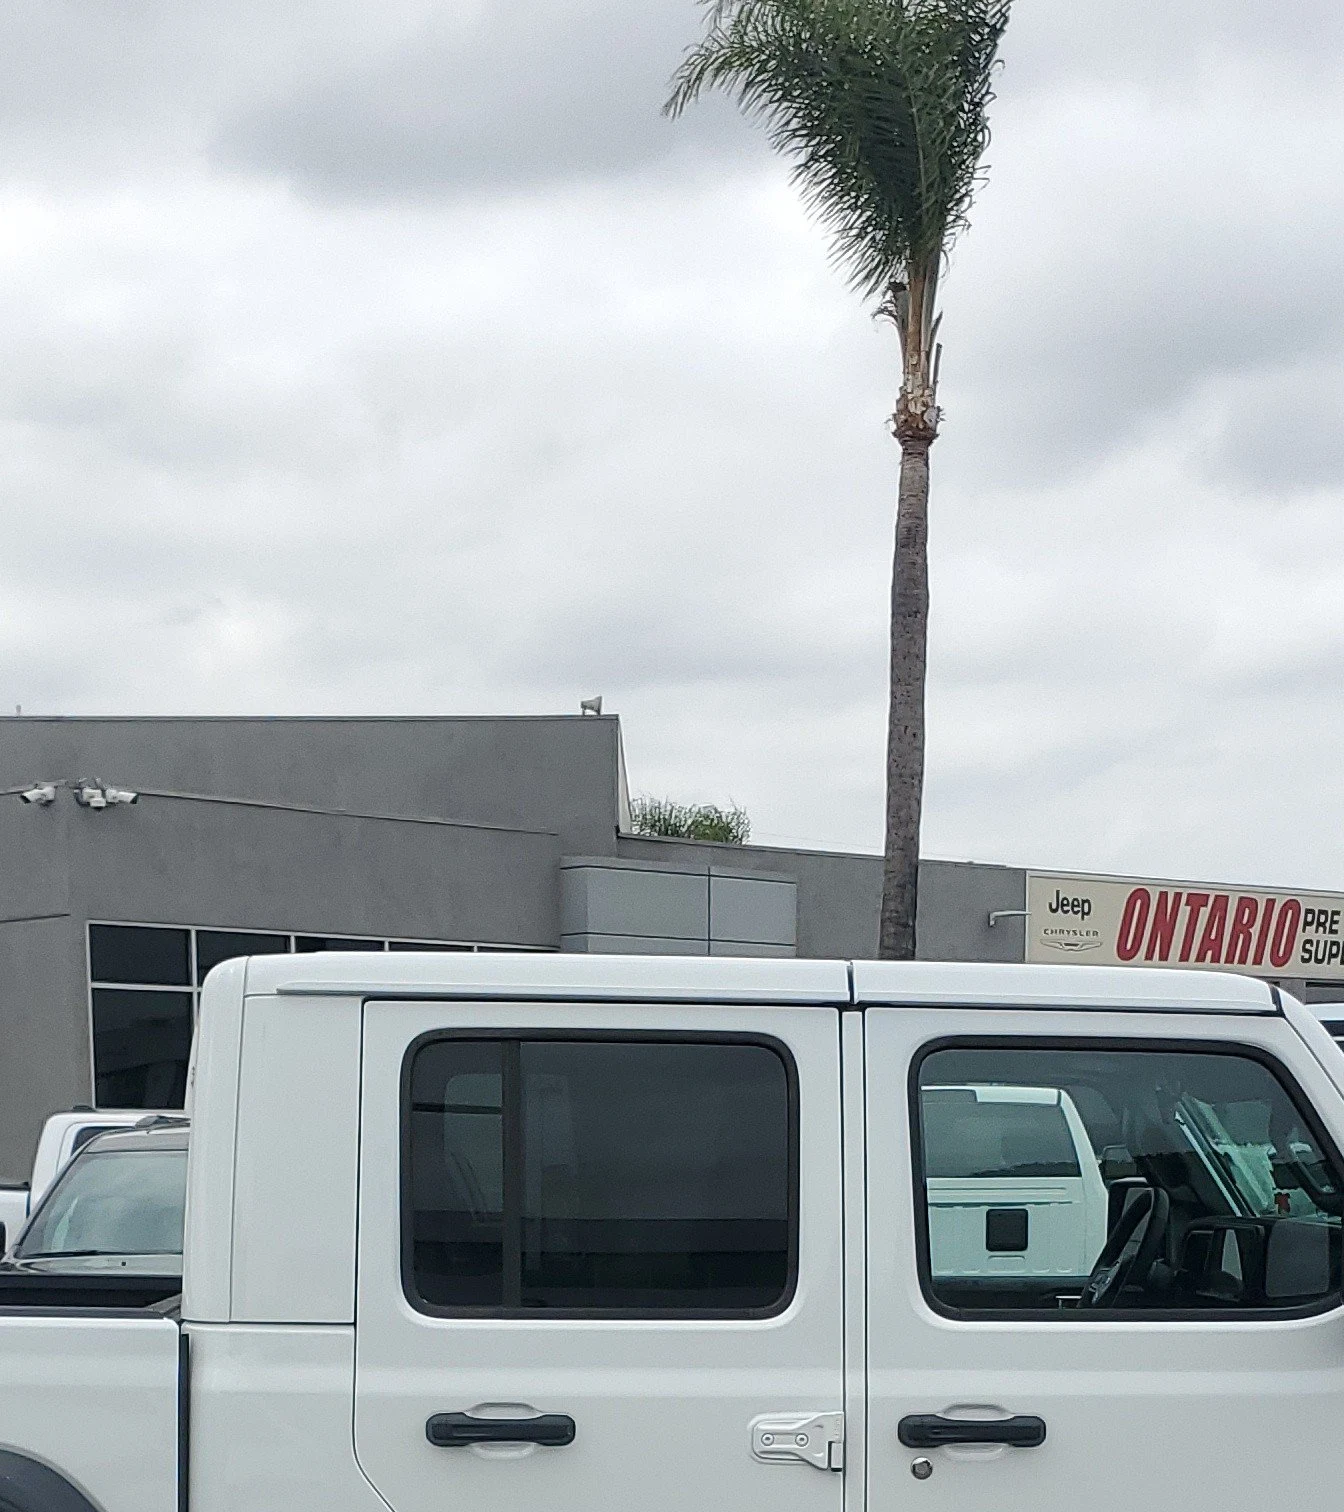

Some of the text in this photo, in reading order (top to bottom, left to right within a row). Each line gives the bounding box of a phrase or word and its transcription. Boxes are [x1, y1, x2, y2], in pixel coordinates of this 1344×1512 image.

[1048, 889, 1092, 921] Jeep
[1043, 928, 1099, 937] CHRYSLER
[1116, 887, 1302, 968] ONTARIO
[1302, 907, 1341, 935] PRE
